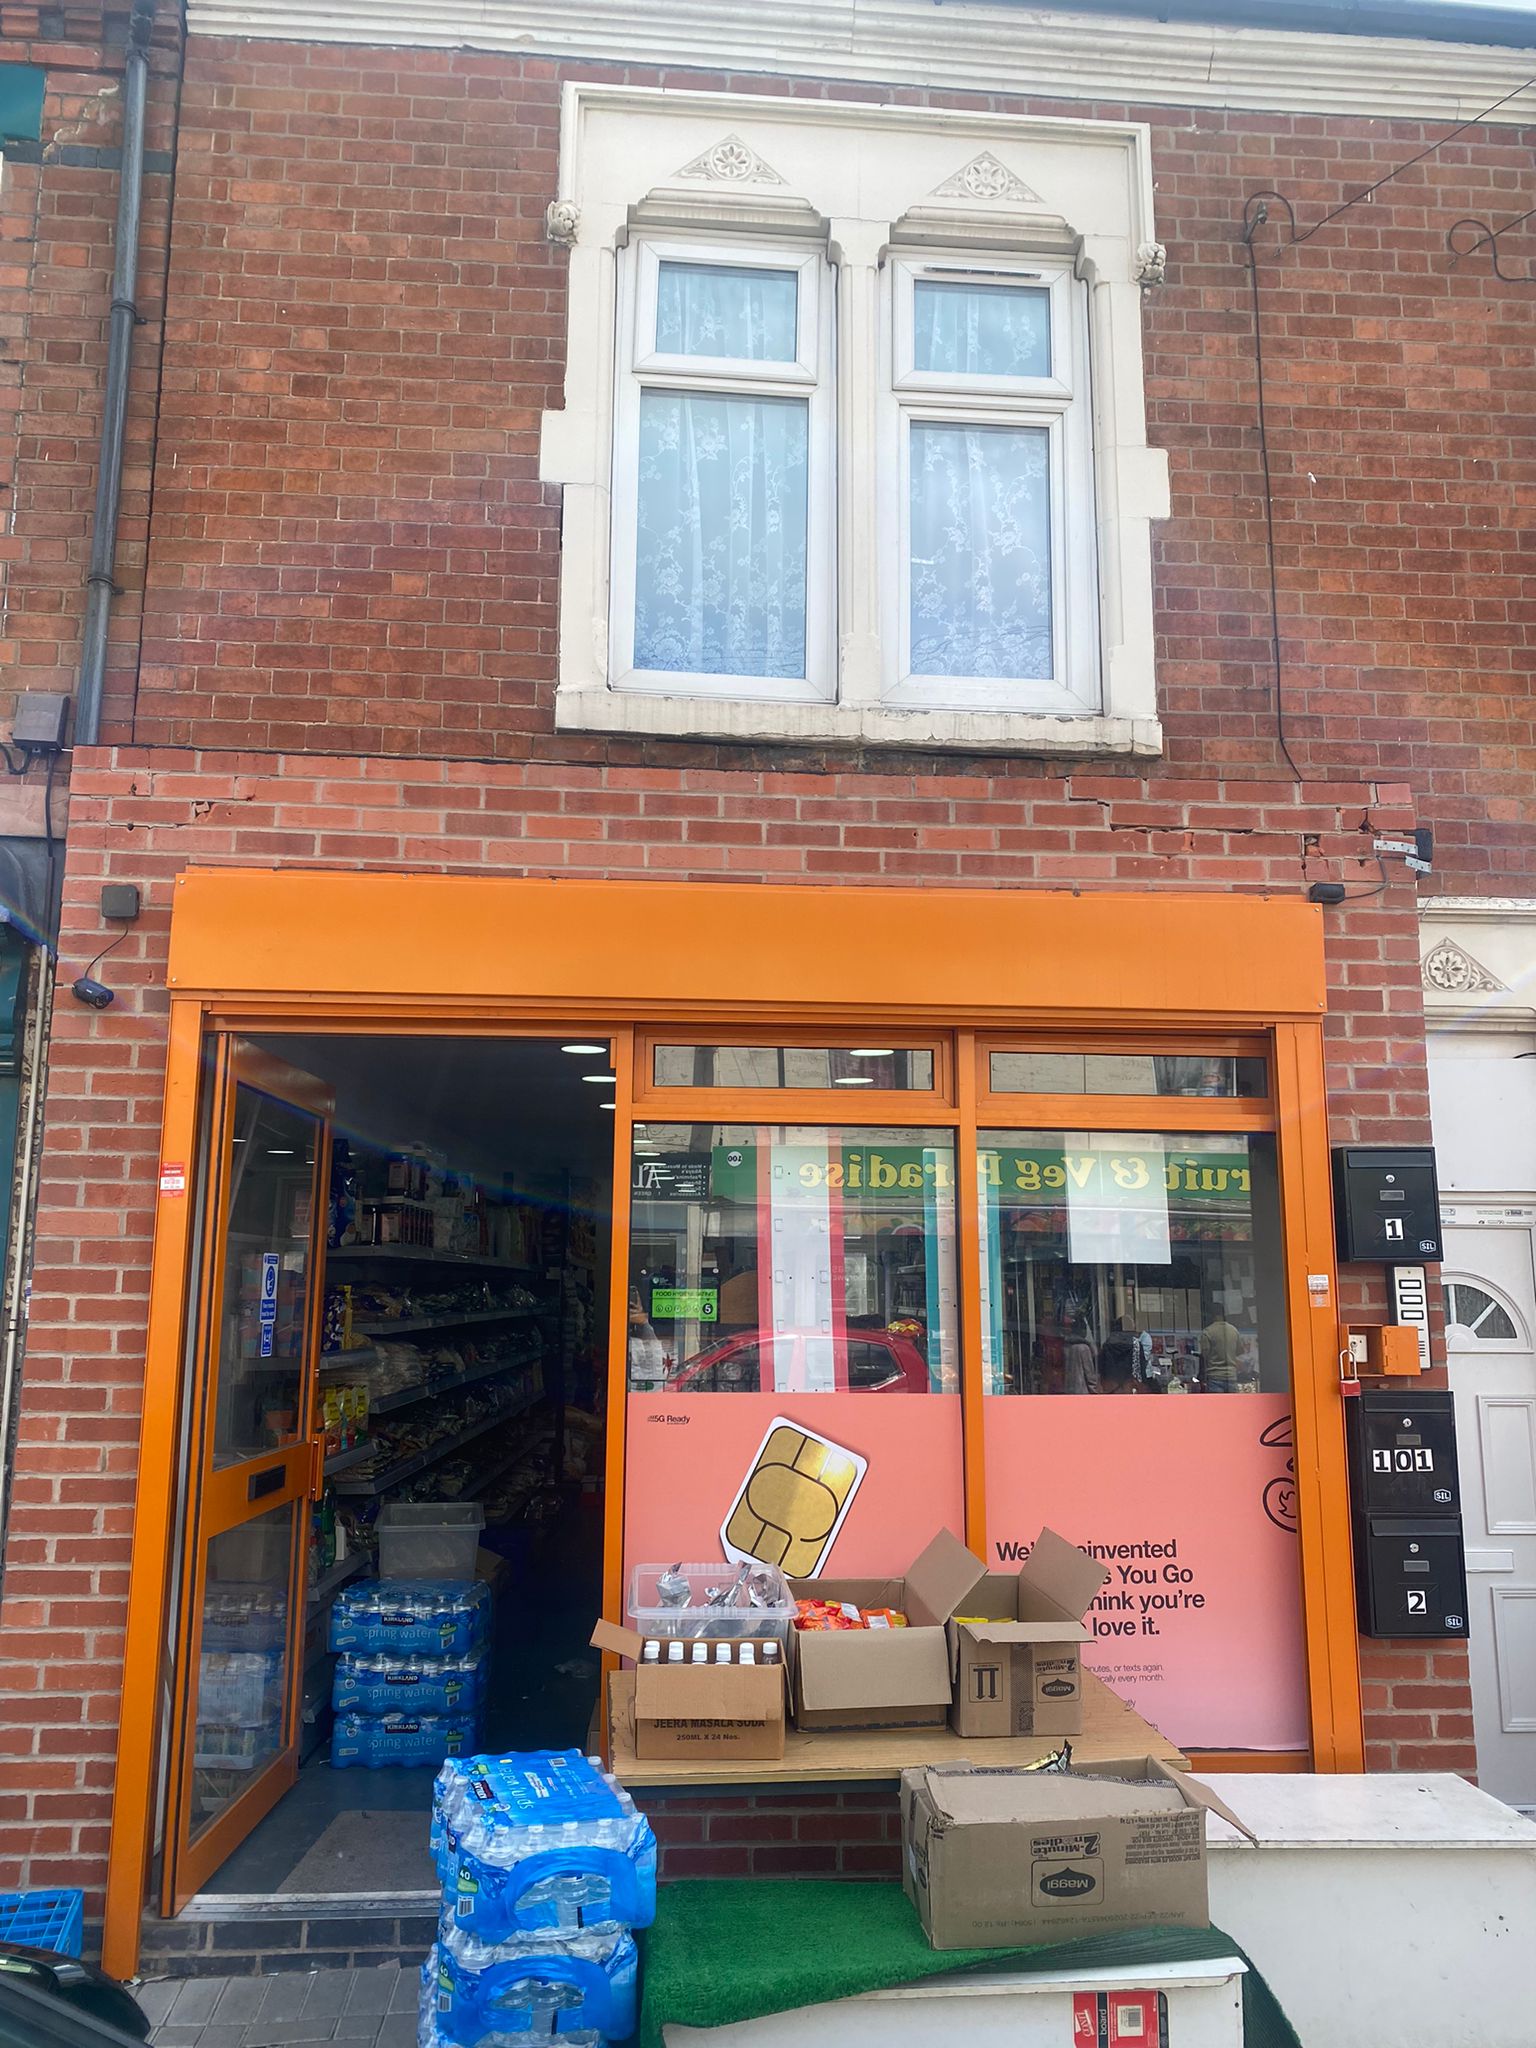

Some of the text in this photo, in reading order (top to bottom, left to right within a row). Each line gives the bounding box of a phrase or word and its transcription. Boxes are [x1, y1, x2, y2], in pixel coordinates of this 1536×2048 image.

[1387, 1220, 1402, 1239] 1
[667, 1414, 690, 1424] Ready
[1375, 1450, 1432, 1470] 101
[996, 1541, 1034, 1561] We'
[1116, 1564, 1157, 1585] You
[1162, 1564, 1194, 1584] Go
[1088, 1589, 1206, 1614] hink you're
[1409, 1592, 1425, 1612] 2
[1092, 1616, 1160, 1636] love it.
[363, 1627, 432, 1640] spring water
[1123, 1663, 1141, 1672] texts
[1117, 1674, 1137, 1684] every
[367, 1687, 437, 1699] spring water
[654, 1719, 688, 1728] JEERA
[690, 1719, 734, 1728] MASALA
[367, 1736, 437, 1750] spring water
[460, 1869, 471, 1880] 40
[1047, 1879, 1089, 1889] Maggi
[1099, 2008, 1107, 2036] board
